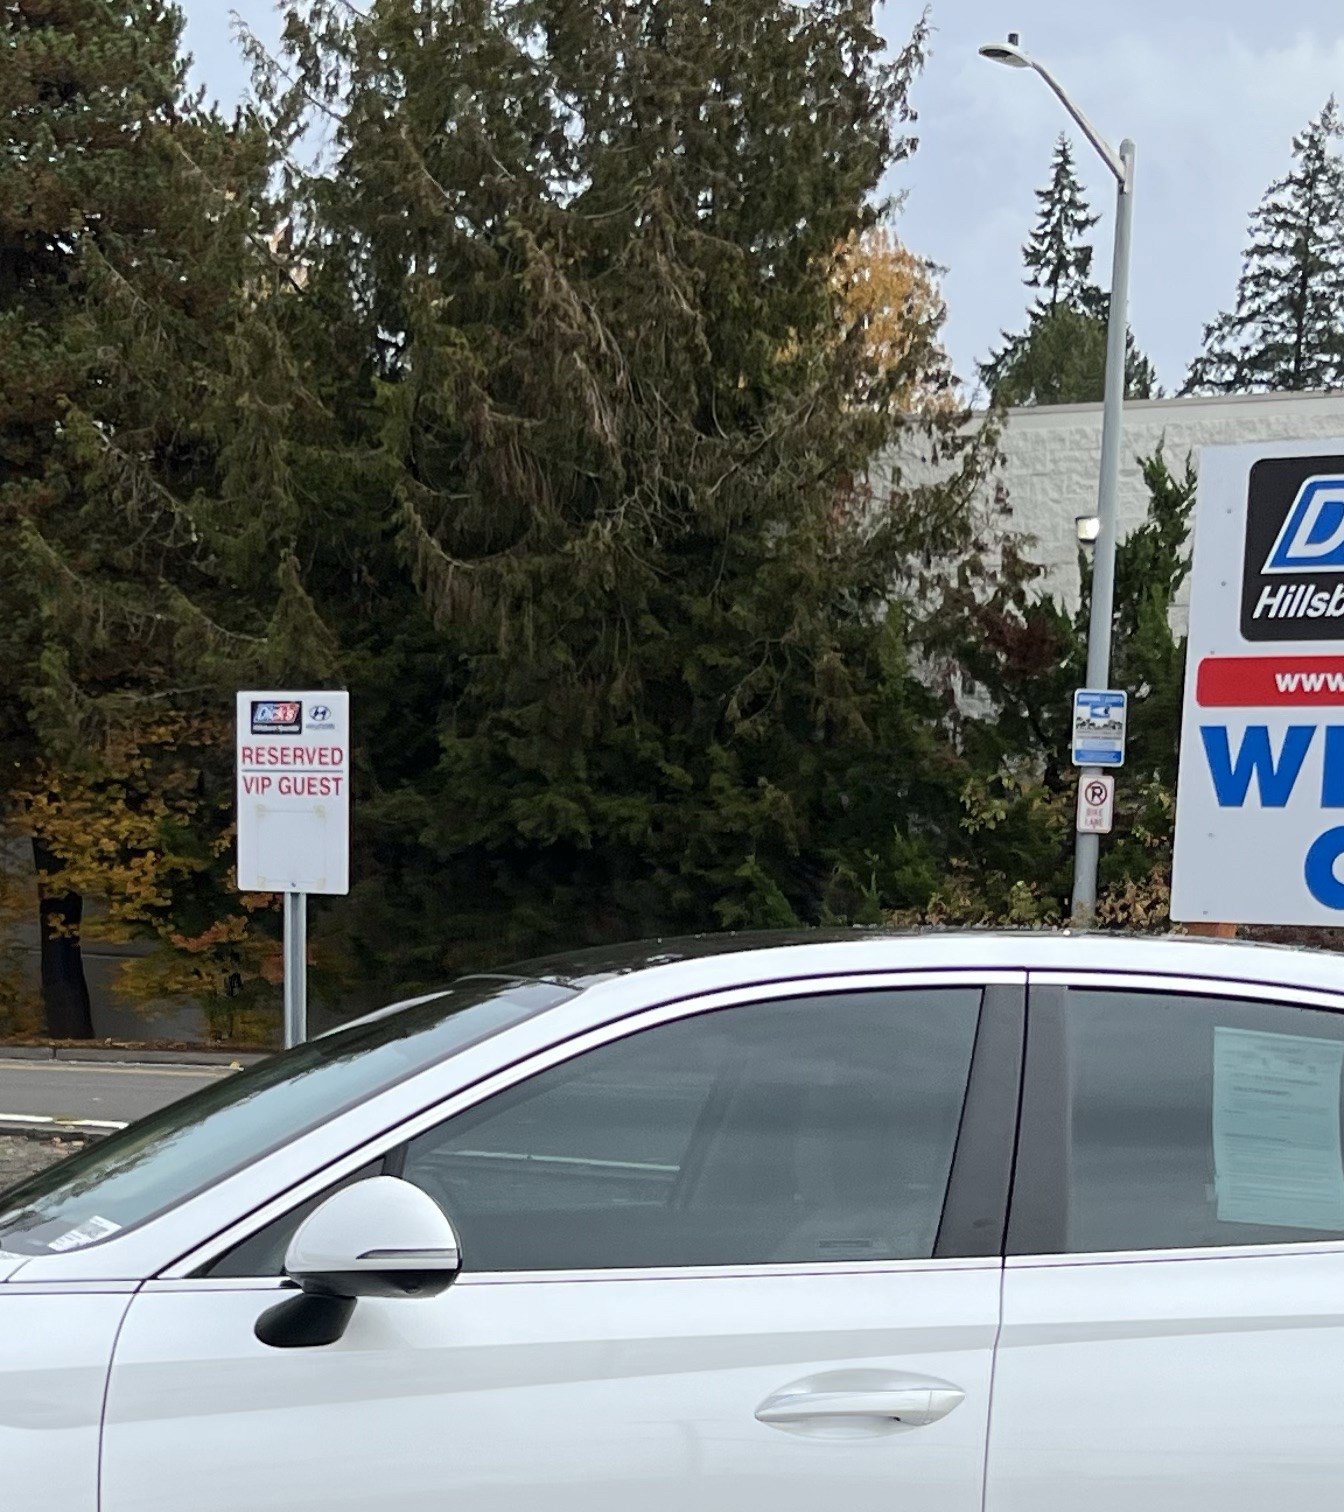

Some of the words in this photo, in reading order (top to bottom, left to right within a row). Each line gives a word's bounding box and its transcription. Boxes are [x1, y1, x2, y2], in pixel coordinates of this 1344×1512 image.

[242, 746, 343, 766] RESERVED
[243, 776, 272, 795] VIP
[278, 776, 343, 796] GUEST
